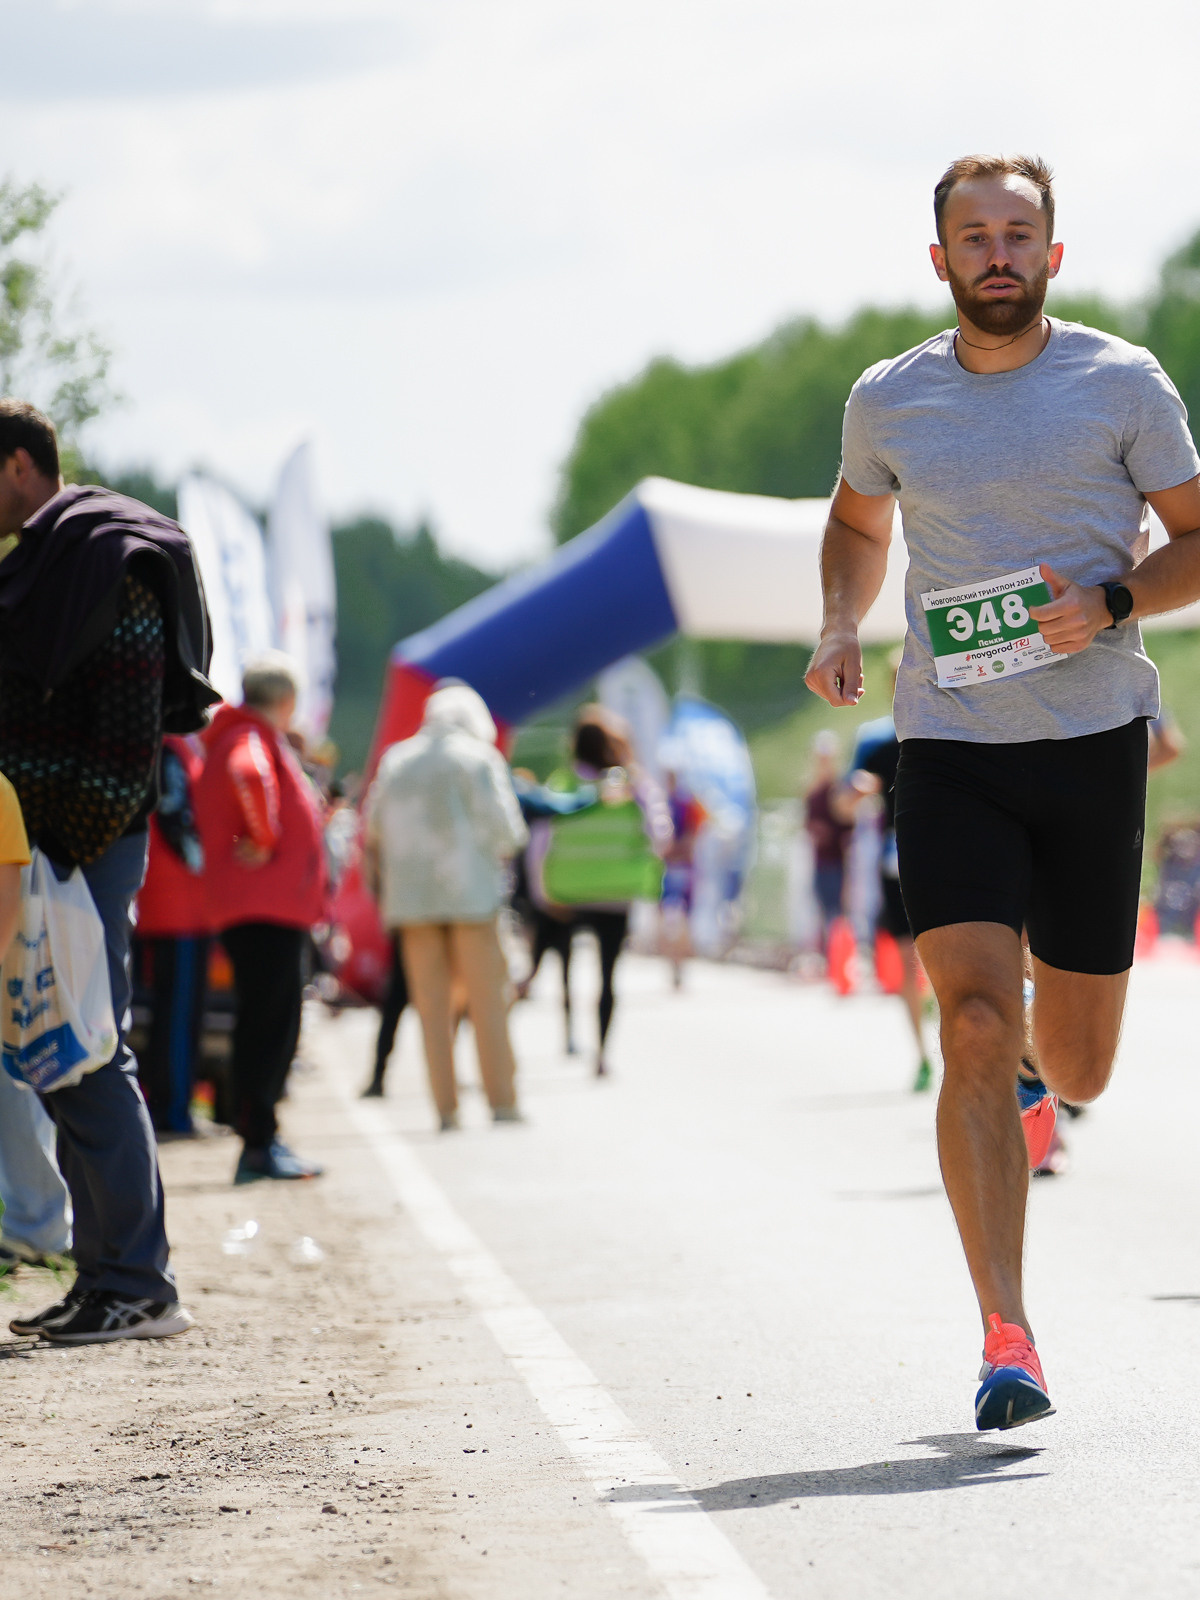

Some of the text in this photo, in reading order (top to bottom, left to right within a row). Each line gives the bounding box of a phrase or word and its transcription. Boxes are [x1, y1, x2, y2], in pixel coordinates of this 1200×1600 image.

[931, 577, 1034, 606] НОВГОРОДСКИЙ ТРИАТЛОН 2023
[946, 594, 1030, 642] Э48
